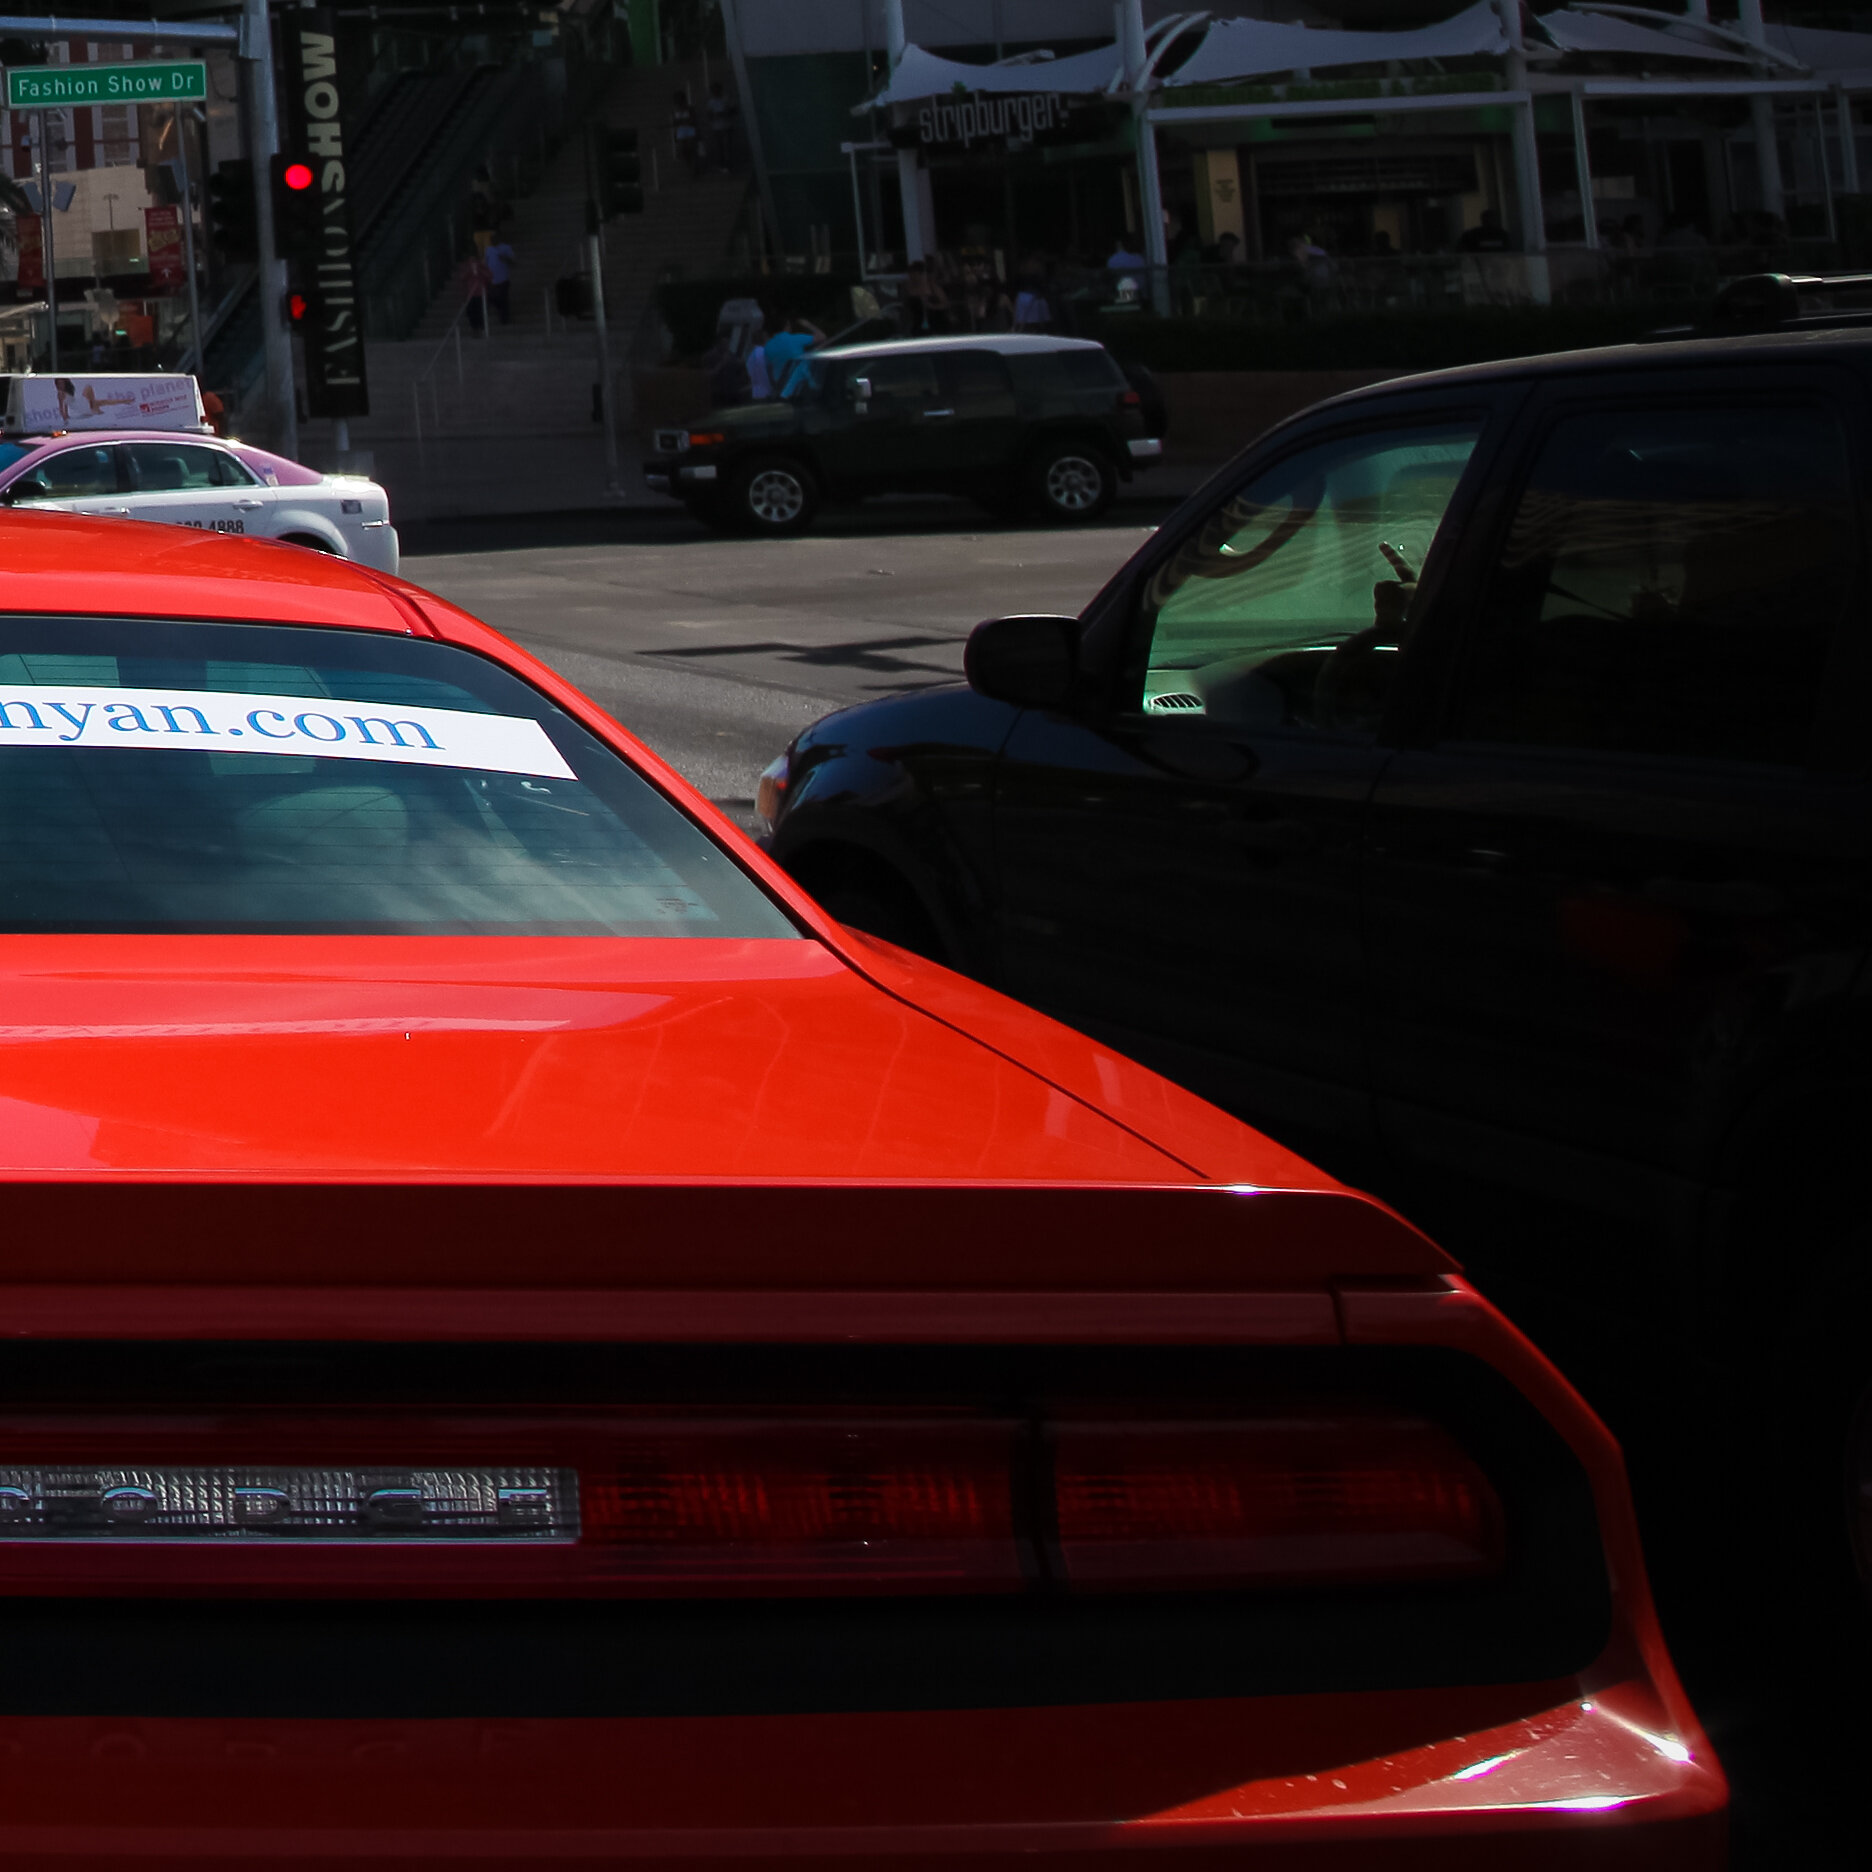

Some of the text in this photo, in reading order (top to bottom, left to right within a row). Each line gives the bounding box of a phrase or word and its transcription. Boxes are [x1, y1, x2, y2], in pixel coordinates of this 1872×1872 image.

[19, 72, 194, 97] Fashion Show Dr
[299, 30, 346, 194] SHOW
